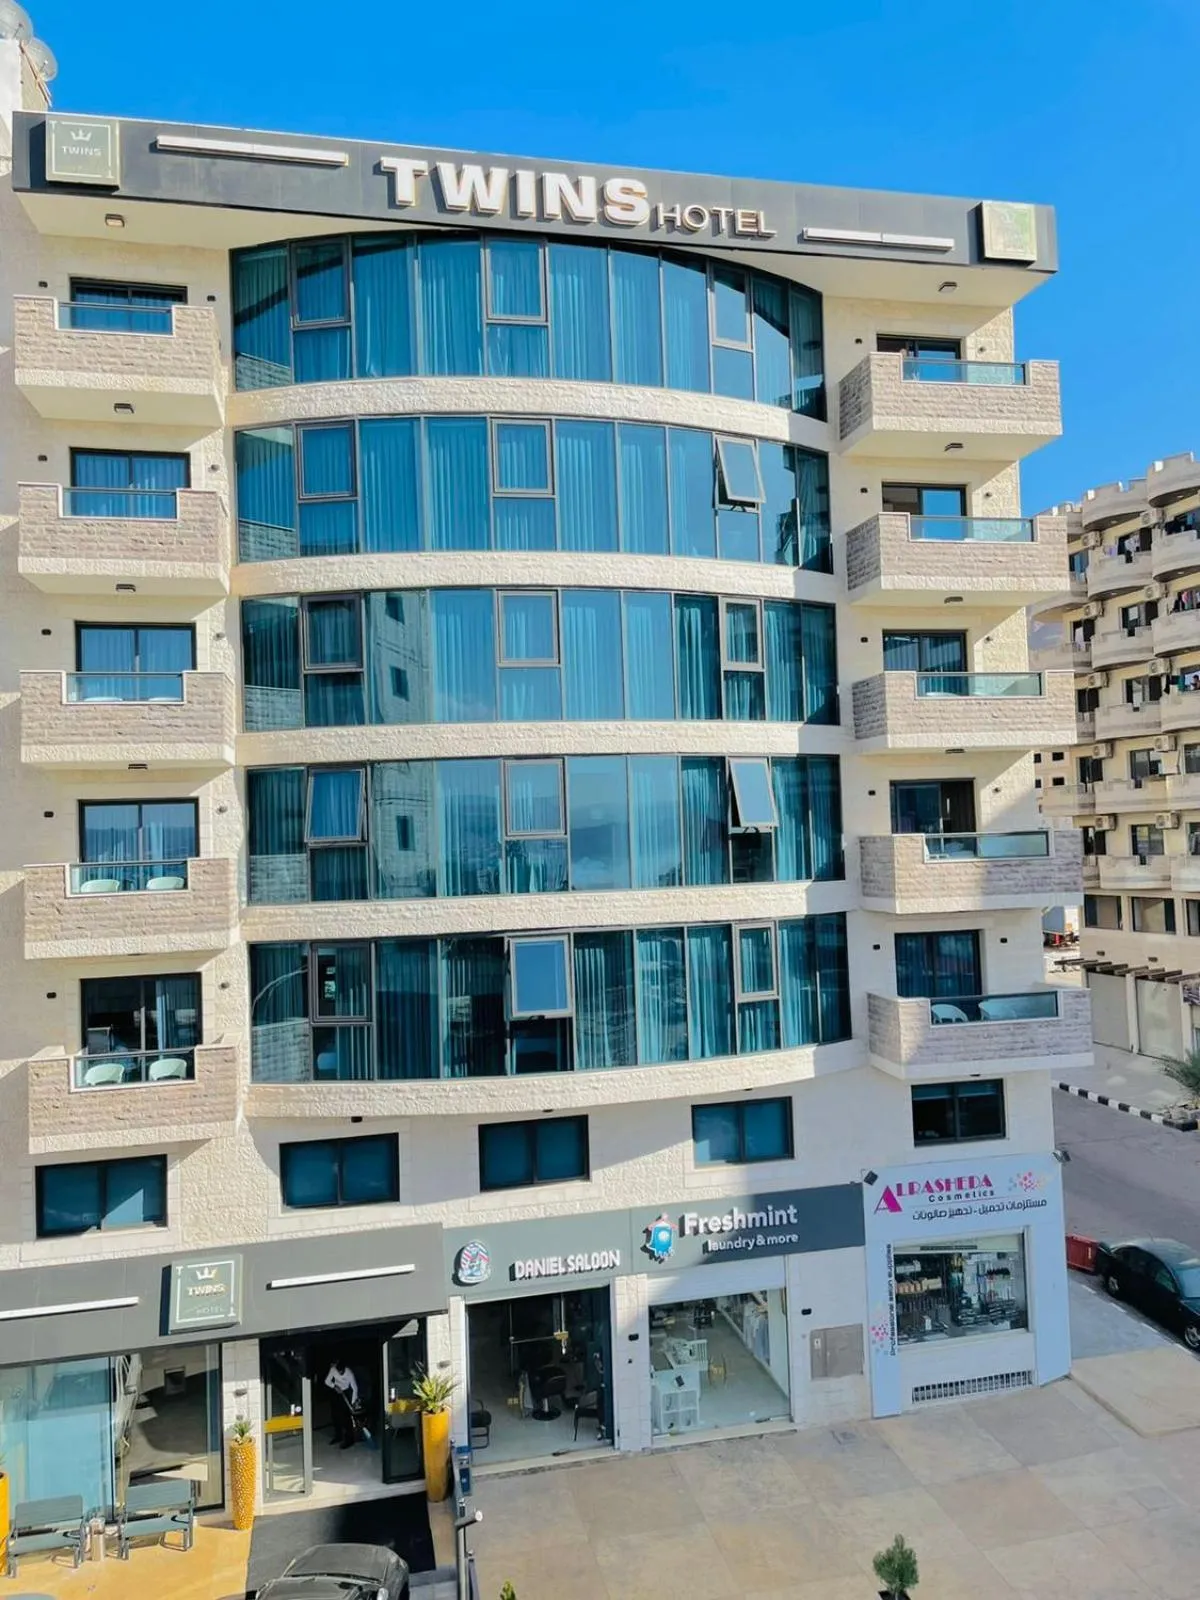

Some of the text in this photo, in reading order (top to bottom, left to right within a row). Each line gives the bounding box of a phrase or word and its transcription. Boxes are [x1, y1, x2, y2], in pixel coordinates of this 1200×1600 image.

[62, 145, 102, 156] TWINS
[380, 156, 778, 239] TWINS HOTEL
[928, 1190, 995, 1203] Cosmetics
[1005, 1198, 1047, 1211] مستلزمات
[684, 1204, 799, 1236] Freshmint
[514, 1249, 621, 1279] DANIEL SALOON
[187, 1283, 227, 1297] TWINS
